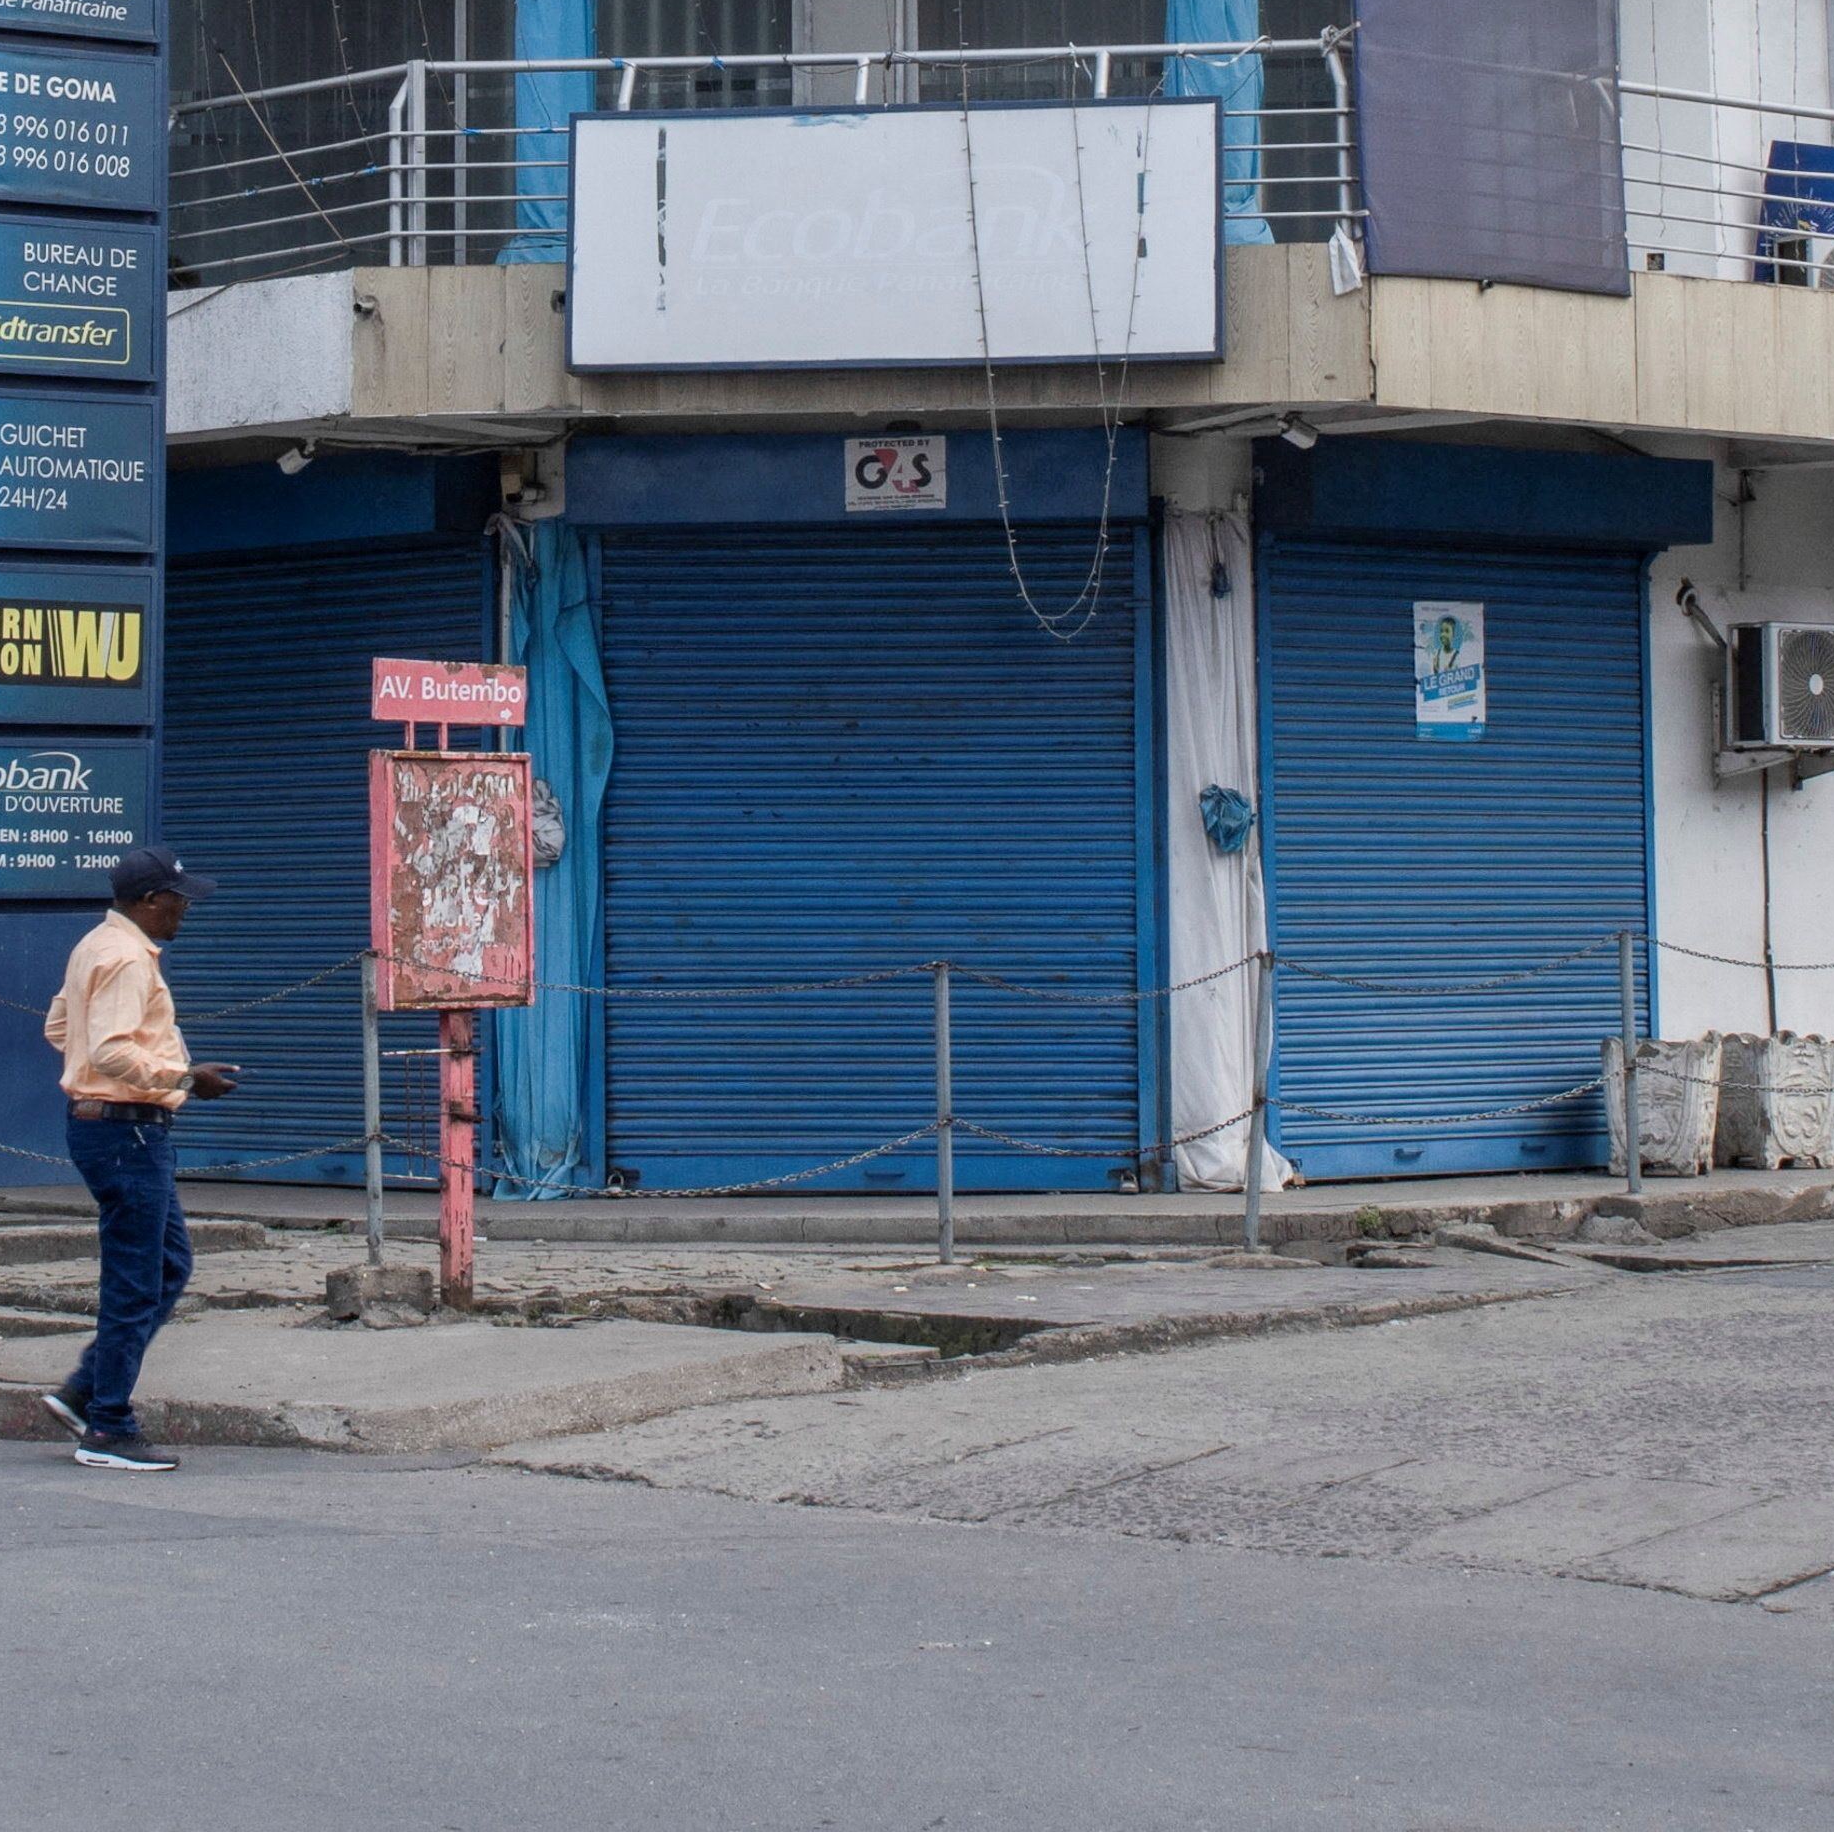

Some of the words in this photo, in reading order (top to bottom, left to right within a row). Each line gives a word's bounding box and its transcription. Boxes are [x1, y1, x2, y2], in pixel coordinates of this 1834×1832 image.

[15, 73, 40, 96] DE
[46, 77, 116, 103] GOMA
[13, 115, 49, 139] 996
[54, 119, 90, 143] 016
[95, 122, 128, 146] 011
[13, 146, 48, 169] 996
[54, 150, 88, 174] 016
[95, 155, 131, 178] 008
[23, 241, 104, 267] BUREAU
[110, 249, 137, 269] DE
[23, 270, 118, 297] CHANGE
[0, 423, 87, 448] GUICHET
[859, 439, 915, 448] PROTECTED
[917, 438, 930, 447] BY
[0, 455, 145, 483] AUTOMATIQUE
[855, 449, 932, 493] G4S
[0, 486, 68, 511] 24H/24
[58, 608, 141, 681] WU
[379, 676, 413, 700] AV.
[421, 677, 522, 704] Butembo
[1424, 676, 1437, 690] LE
[1438, 667, 1475, 687] GRAND
[5, 796, 124, 814] D'OUVERTURE
[30, 829, 69, 844] 8H00
[87, 830, 133, 845] 16H00
[17, 854, 56, 868] 9H00
